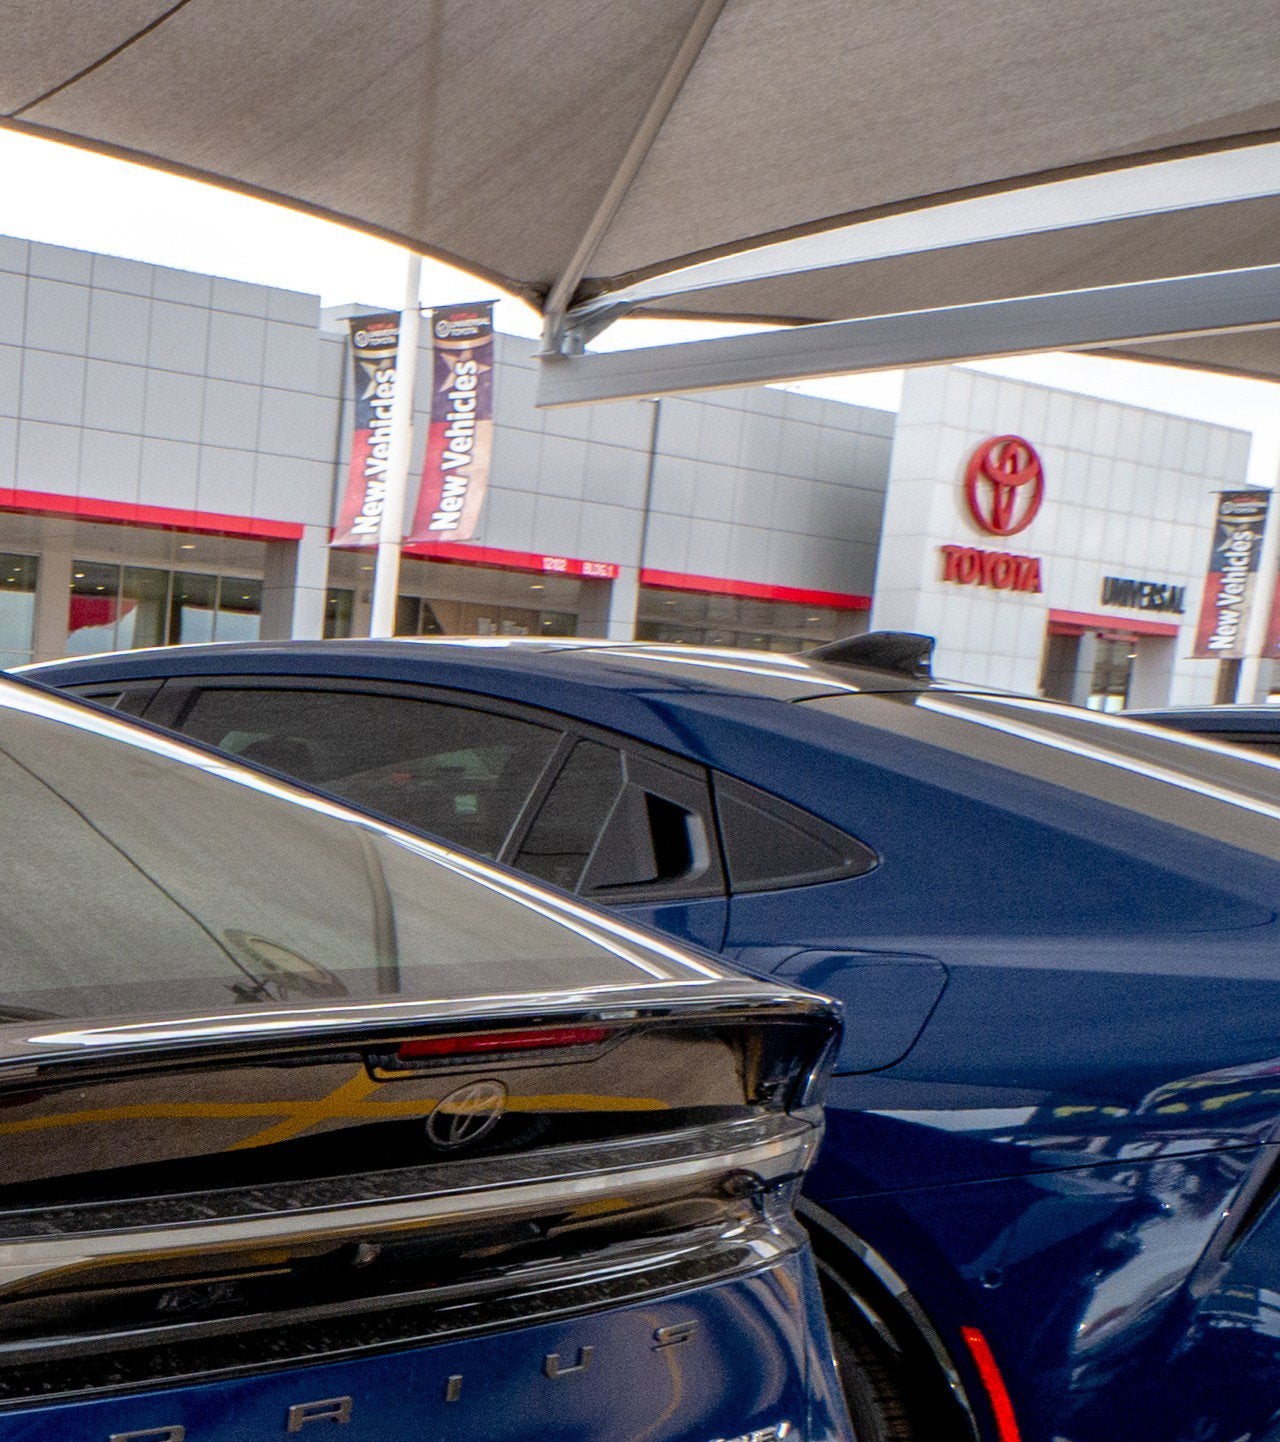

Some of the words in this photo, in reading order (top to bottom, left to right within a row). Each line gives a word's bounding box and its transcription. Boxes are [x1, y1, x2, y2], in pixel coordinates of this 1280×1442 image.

[364, 368, 397, 477] Vehicles
[440, 360, 478, 471] Vehicles
[351, 478, 387, 534] New
[429, 475, 469, 531] New
[941, 545, 1042, 593] TOYOTA
[1216, 529, 1254, 607] Vehicles
[1208, 610, 1240, 650] New
